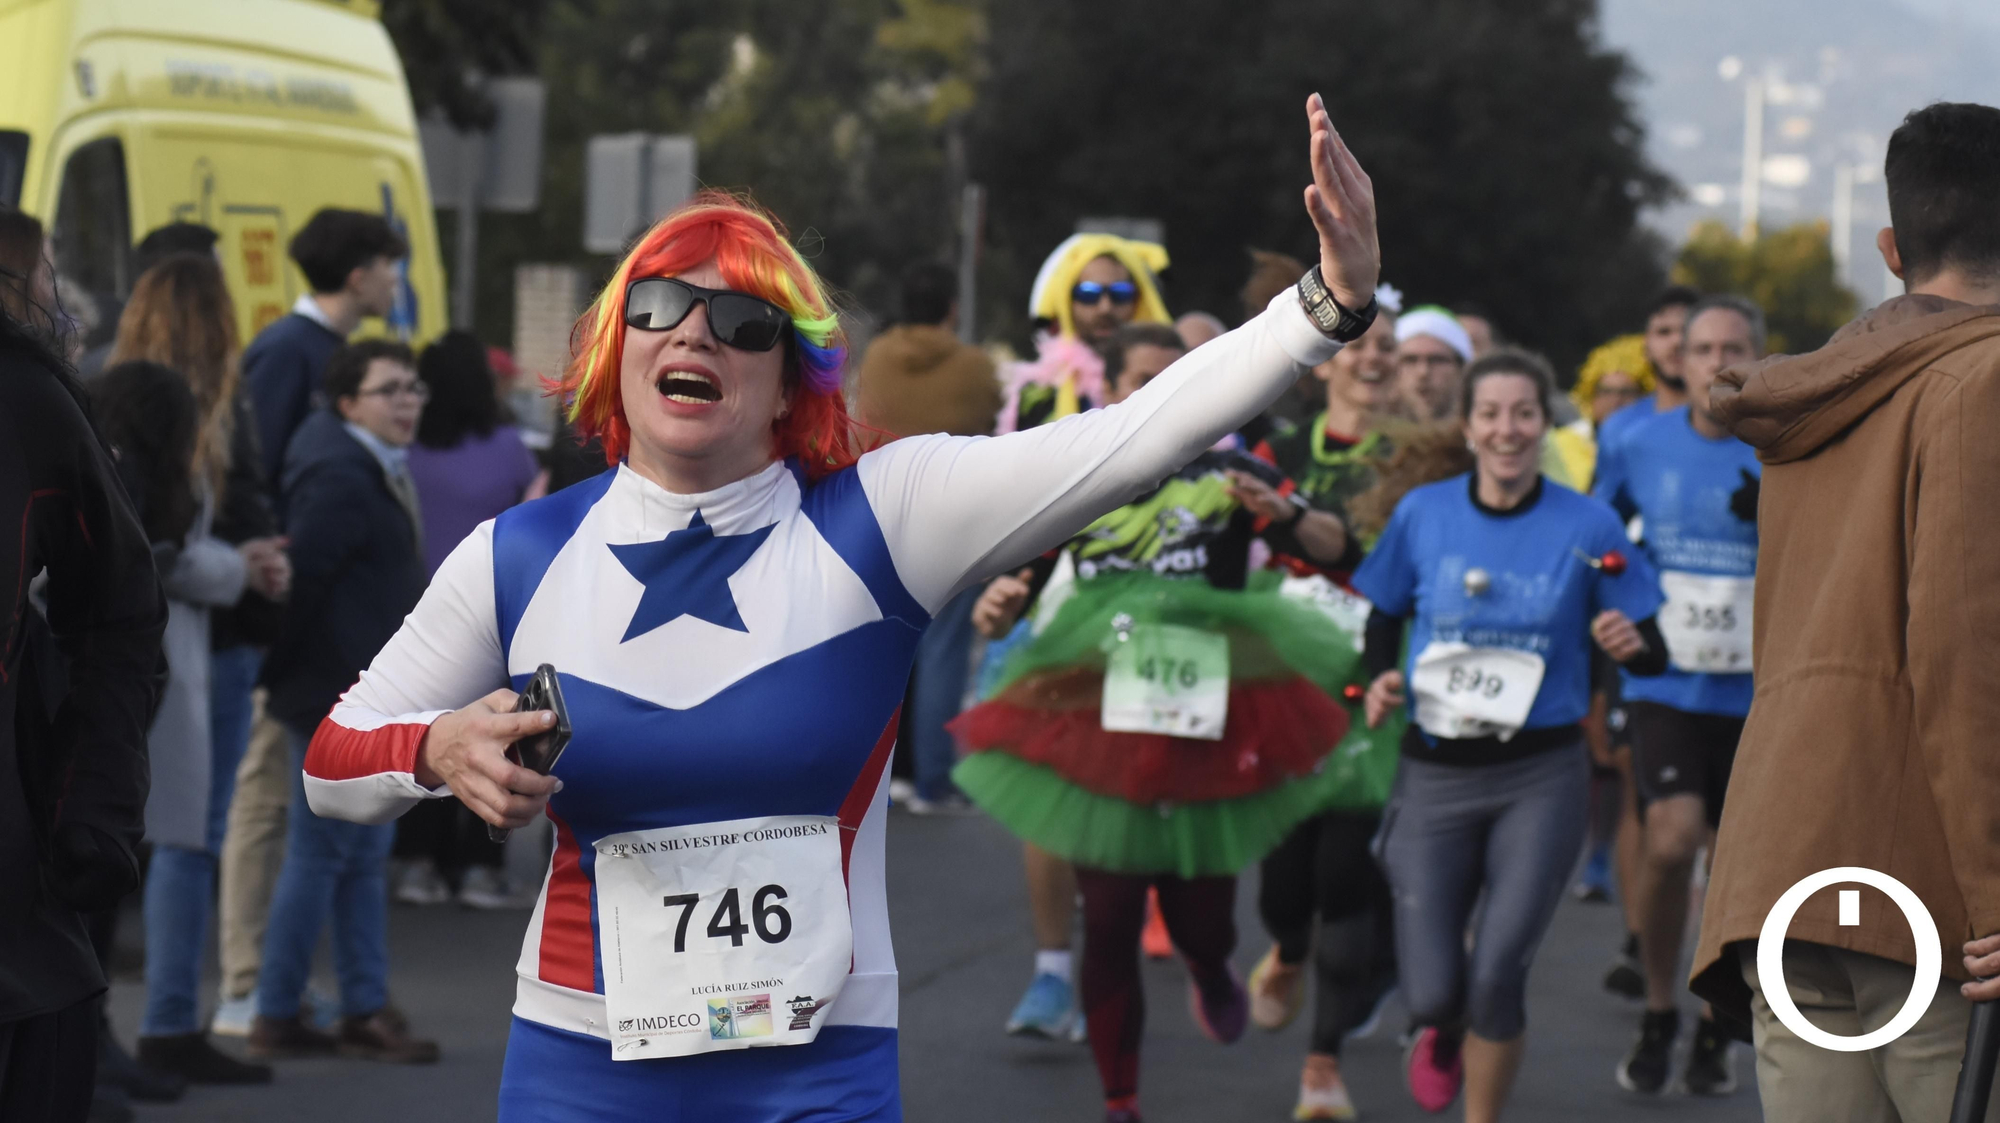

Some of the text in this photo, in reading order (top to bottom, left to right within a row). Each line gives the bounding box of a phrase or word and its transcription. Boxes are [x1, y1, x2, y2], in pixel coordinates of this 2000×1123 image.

[1685, 604, 1737, 631] 355
[1137, 657, 1198, 689] 476
[631, 842, 657, 854] SAN
[660, 834, 740, 852] SILVESTRE
[743, 823, 827, 843] CORDOBESA
[663, 884, 792, 953] 746
[691, 977, 784, 995] LUCÍA RUIZ SIMÓN
[745, 1003, 770, 1011] PARQUE
[637, 1013, 700, 1030] IMDECO
